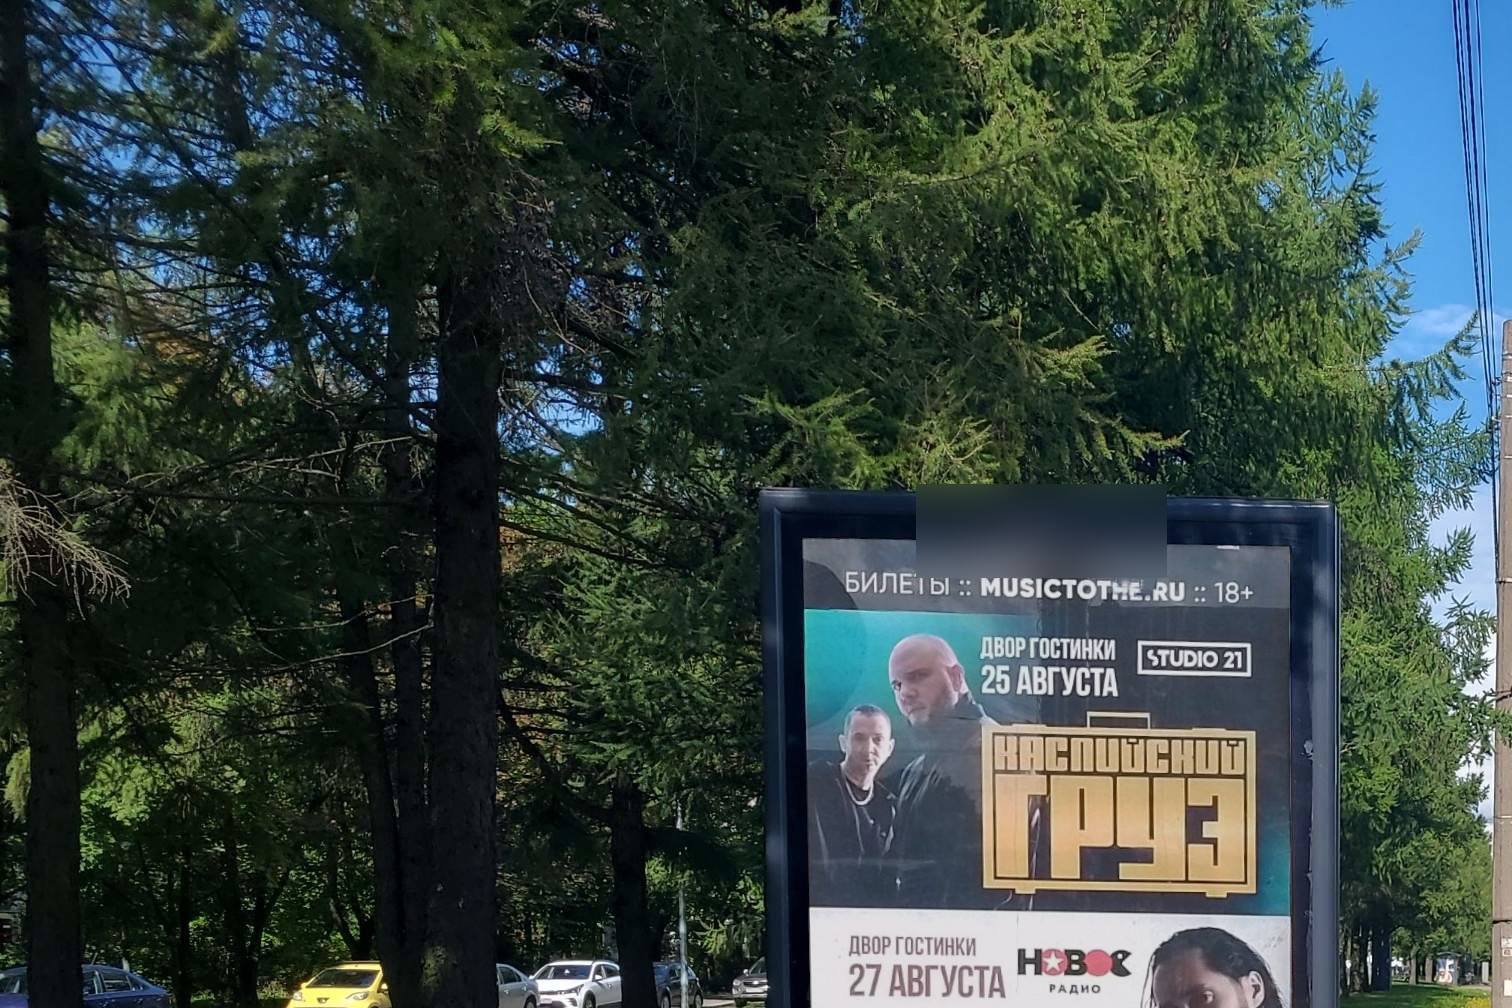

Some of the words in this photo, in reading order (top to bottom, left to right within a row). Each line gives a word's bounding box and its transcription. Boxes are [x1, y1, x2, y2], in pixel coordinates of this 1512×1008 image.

[980, 577, 1186, 602] MUSICTOTHE.RU
[1213, 581, 1255, 604] 18+
[979, 636, 1027, 660] ДВОР
[1028, 637, 1117, 661] ГОСТИНКИ
[1146, 648, 1220, 669] STUDIO
[1223, 650, 1244, 670] 21
[980, 664, 1010, 695] 25
[1015, 666, 1119, 698] АВГУСТА
[994, 735, 1246, 775] КАСПИЙСКИЙ
[994, 774, 1246, 883] ГРУЗ
[848, 935, 892, 957] ДВОР
[894, 936, 977, 957] ГОСТИНКИ
[848, 963, 883, 997] 27
[887, 964, 1007, 999] АВГУСТА
[1048, 983, 1102, 994] РАДИО
